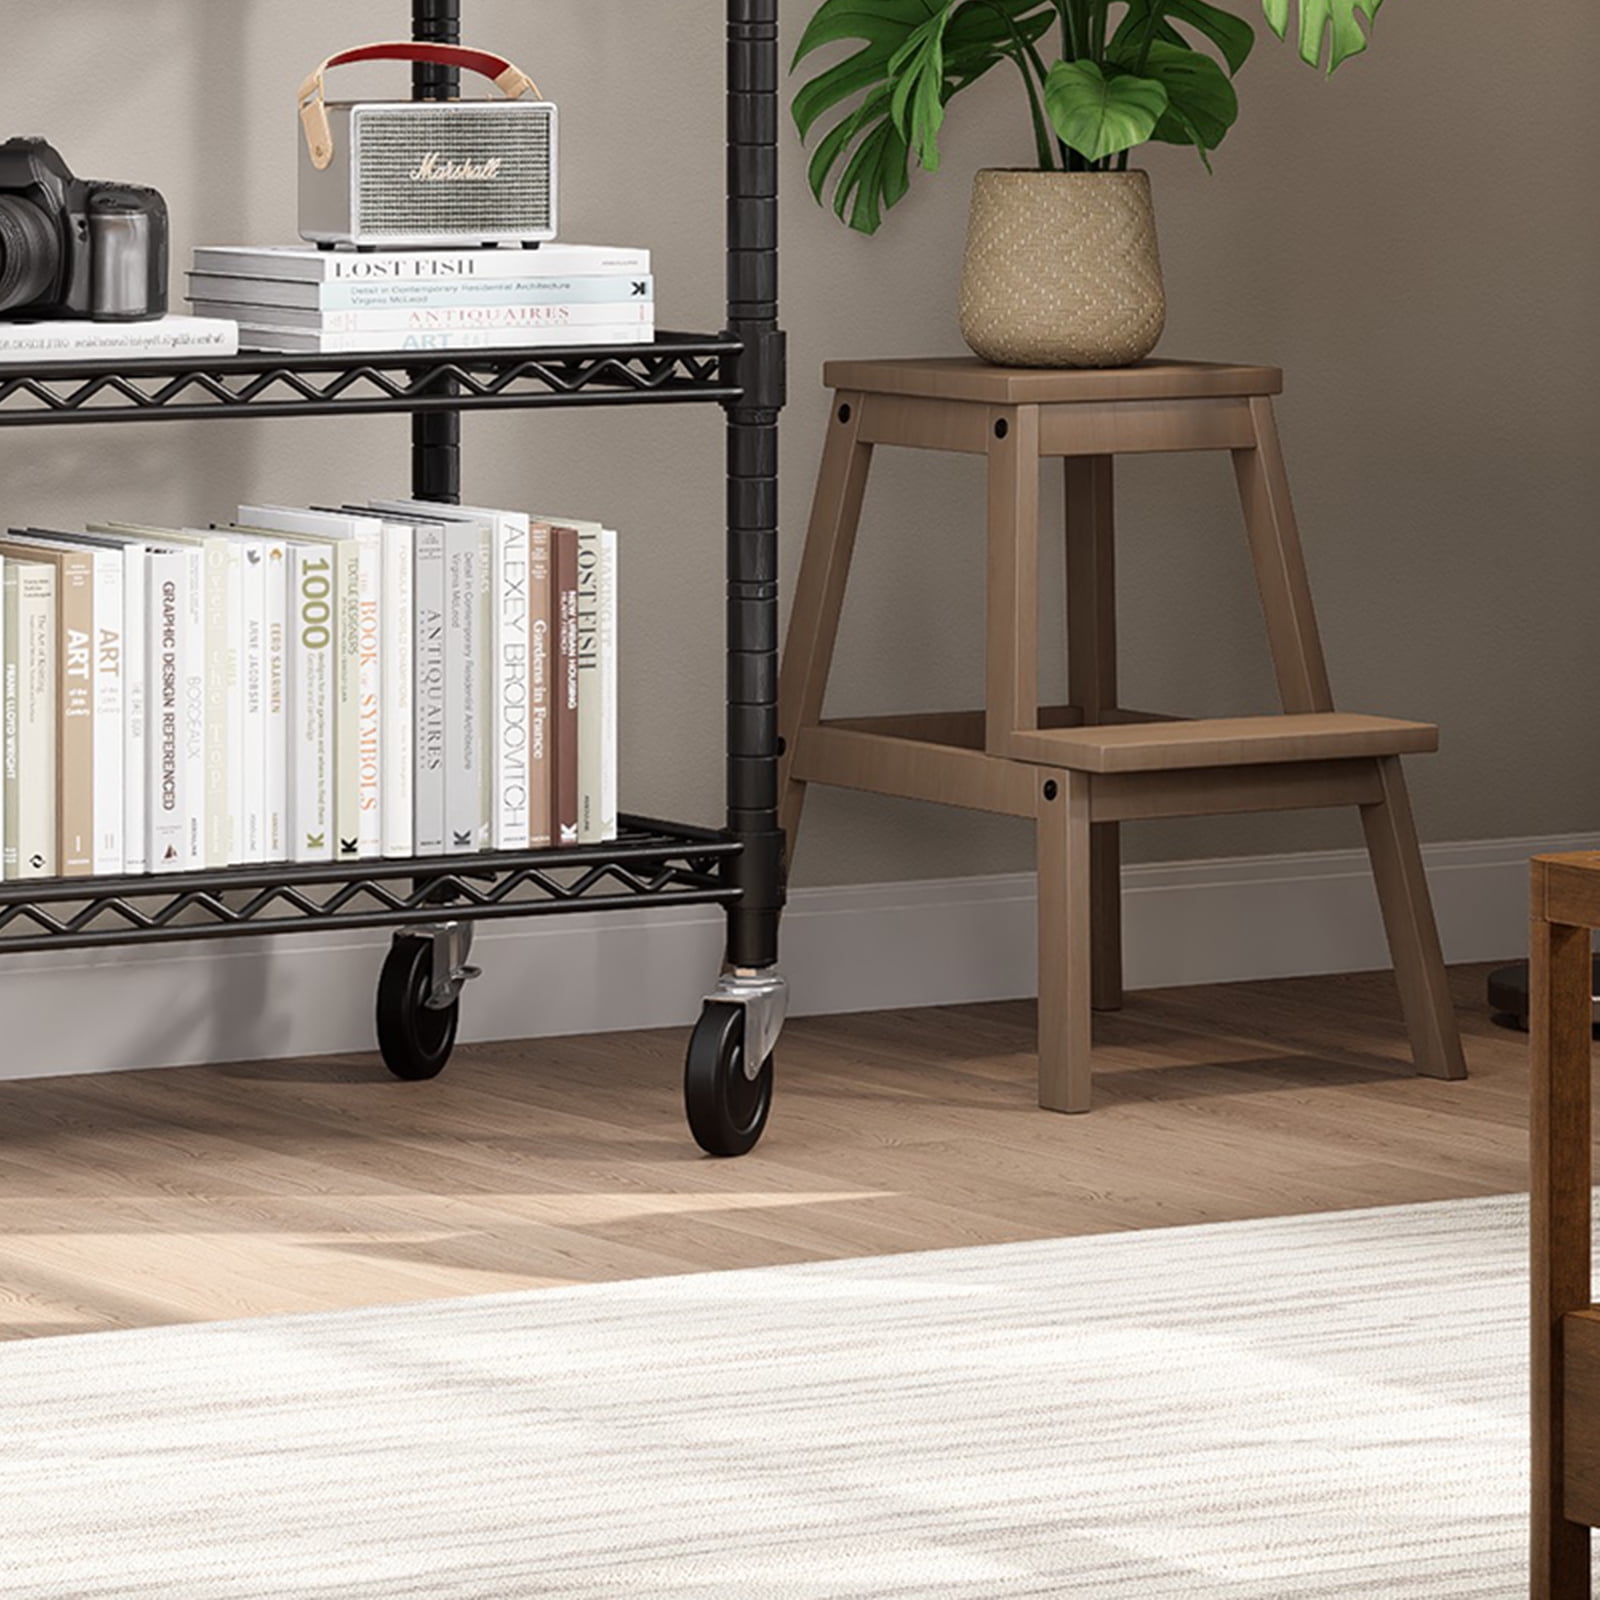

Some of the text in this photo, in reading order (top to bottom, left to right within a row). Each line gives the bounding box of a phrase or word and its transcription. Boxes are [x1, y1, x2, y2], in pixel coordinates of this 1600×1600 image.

[409, 151, 501, 182] Marshall
[334, 258, 475, 278] LOST FISH
[402, 333, 451, 350] ART
[408, 306, 570, 324] ANTIQUAIRES
[301, 558, 330, 650] 1000
[347, 557, 359, 656] TEXTILE DESIGNERS
[449, 553, 461, 628] Virginia McLeod
[579, 534, 598, 671] LOST FISH
[6, 664, 17, 698] FRANK
[66, 629, 90, 679] ART
[99, 629, 119, 677] ART
[248, 654, 259, 713] JACOBSEN
[425, 610, 442, 771] ANTIQUAIRES
[461, 551, 475, 770] Detail in Contemporary Residential Architecture
[503, 524, 526, 828] ALEXEY BRODOVITCH
[532, 620, 547, 759] Gardens in France
[567, 590, 577, 710] NEW URBAN HOUSING
[6, 701, 17, 735] LLOYD
[162, 581, 176, 811] GRAPHIC DESIGN REFERENCED
[359, 600, 378, 811] BOOK SYMBOLS
